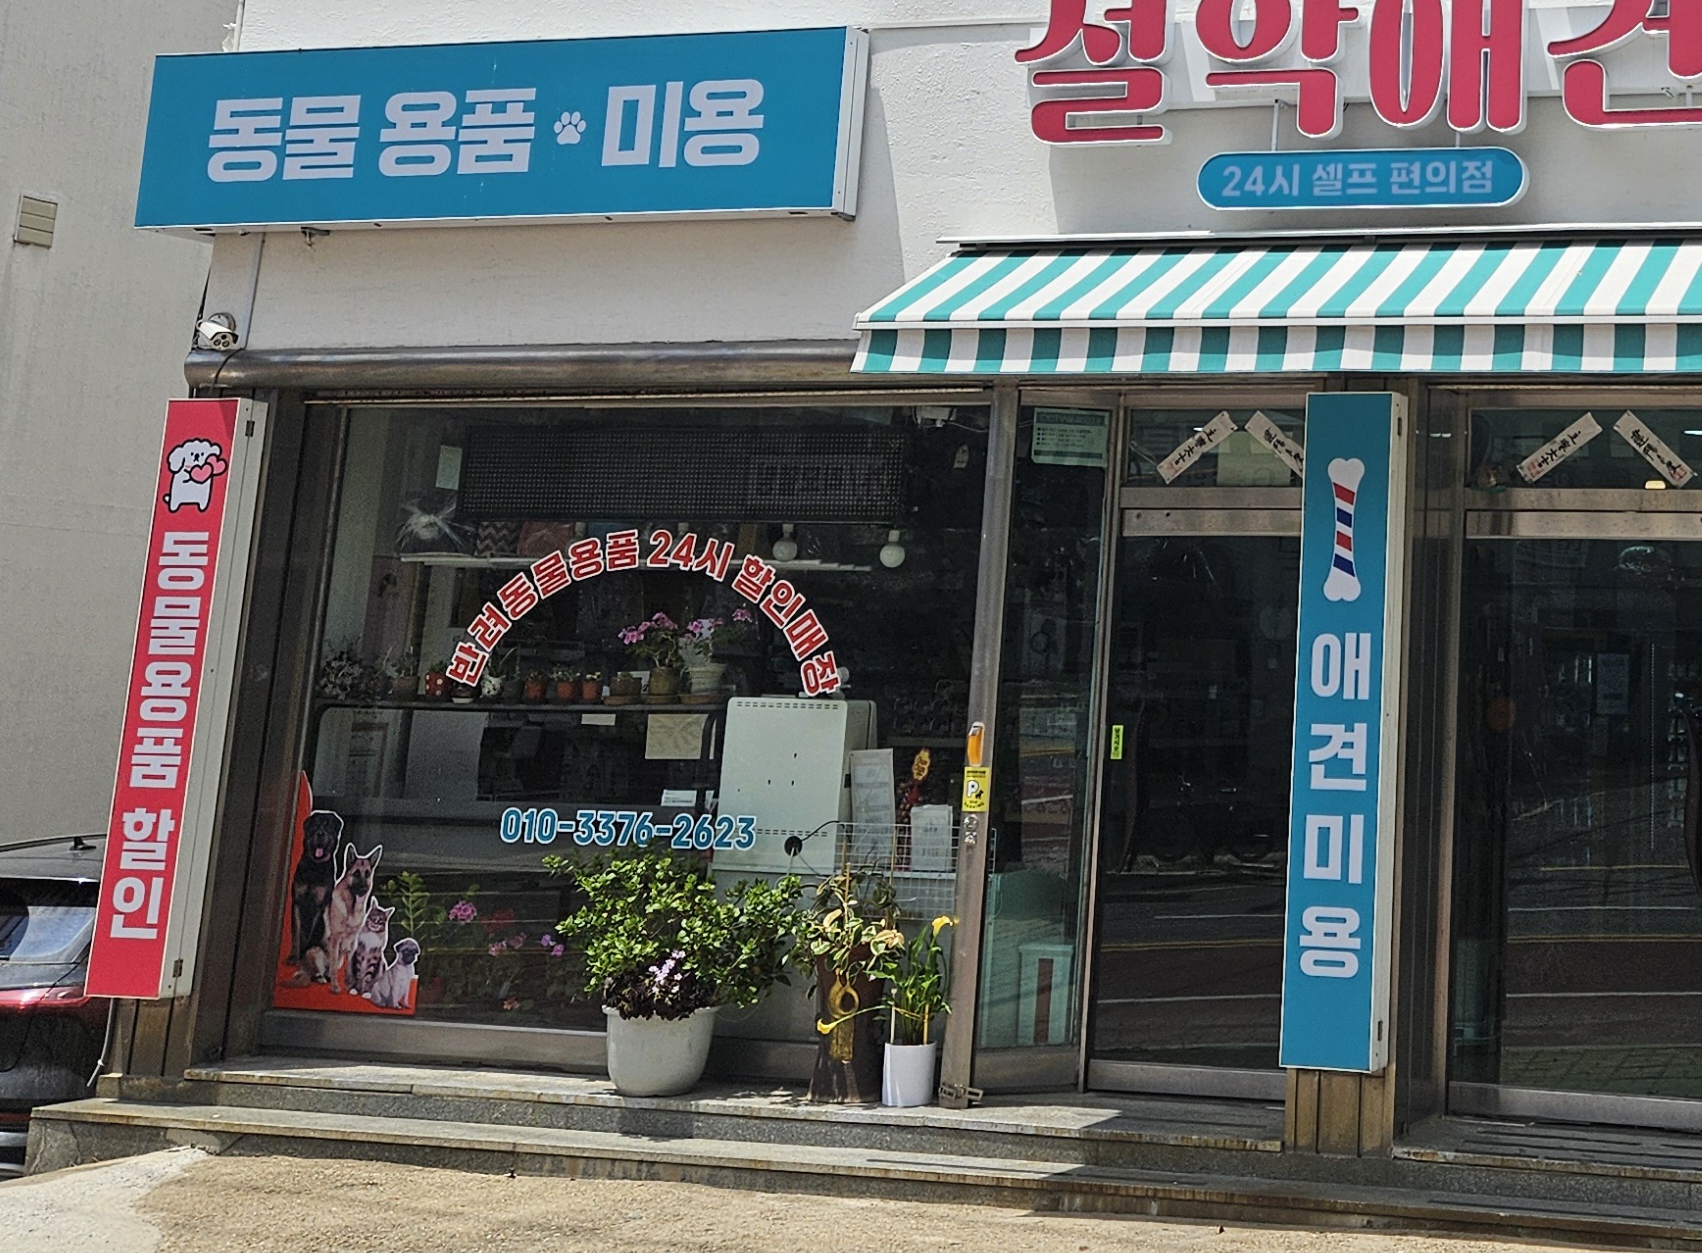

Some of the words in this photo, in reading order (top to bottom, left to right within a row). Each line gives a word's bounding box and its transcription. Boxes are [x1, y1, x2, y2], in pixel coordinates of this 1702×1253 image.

[207, 94, 362, 183] 동물
[377, 87, 537, 178] 용품
[600, 78, 765, 169] 미용
[1221, 163, 1301, 197] 24시
[1312, 162, 1378, 197] 셀프
[1389, 159, 1494, 195] 편의점
[130, 531, 210, 790] 동물용품
[445, 529, 640, 688] 반려동물용품
[646, 529, 736, 583] 24시
[730, 554, 845, 697] 할인매장
[500, 806, 758, 852] 010-3376-2623
[966, 780, 980, 798] P
[1299, 632, 1373, 979] 애견미용
[110, 807, 176, 941] 할인
